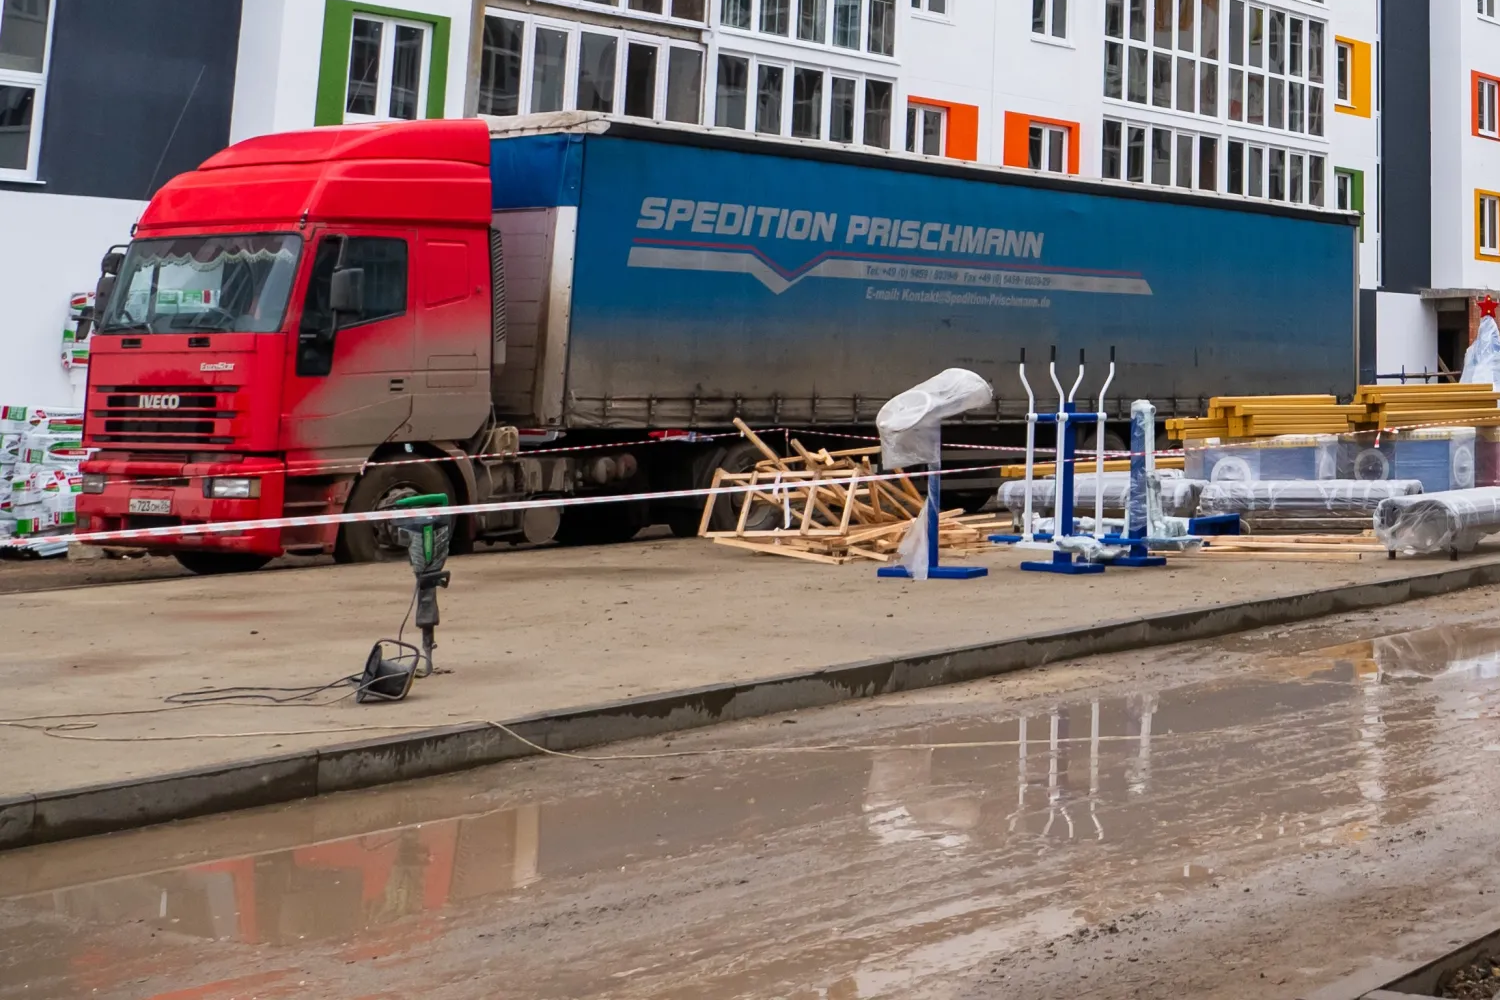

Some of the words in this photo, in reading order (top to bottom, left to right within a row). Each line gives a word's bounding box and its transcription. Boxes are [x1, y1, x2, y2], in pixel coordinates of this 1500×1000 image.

[636, 197, 837, 243] SPEDITION
[846, 215, 1044, 259] PRISCHMANN
[866, 287, 900, 301] E-mail:
[138, 394, 180, 409] IVECO
